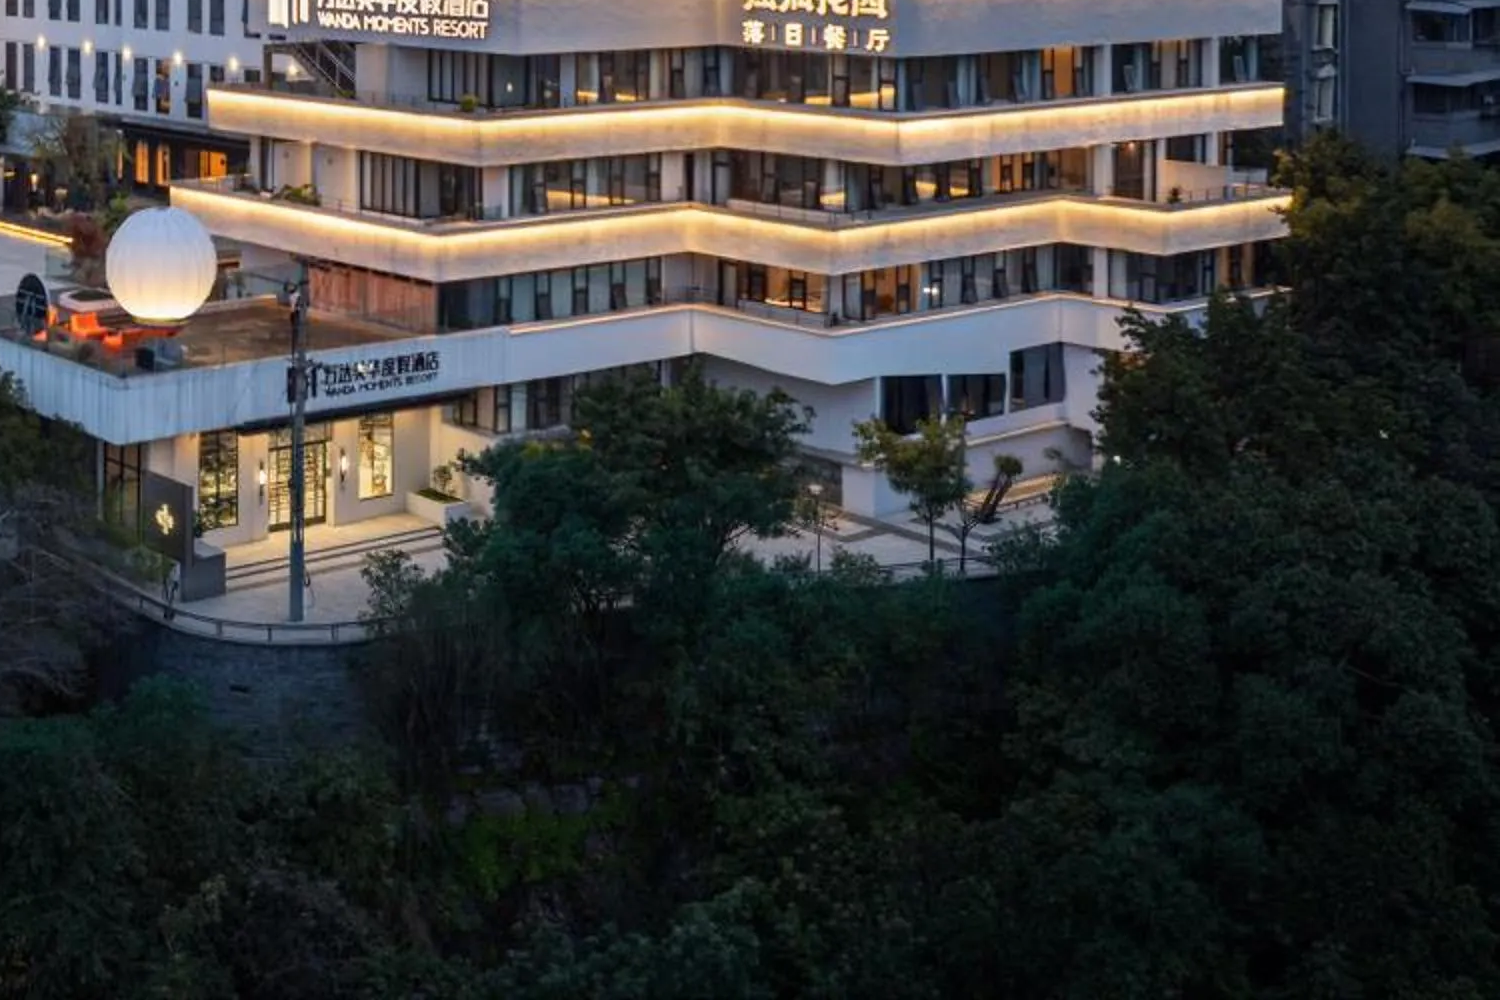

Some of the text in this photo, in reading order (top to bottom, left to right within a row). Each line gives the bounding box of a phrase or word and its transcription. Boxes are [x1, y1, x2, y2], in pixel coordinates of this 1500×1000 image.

[317, 10, 489, 39] WANDA MOMENTS RESORT
